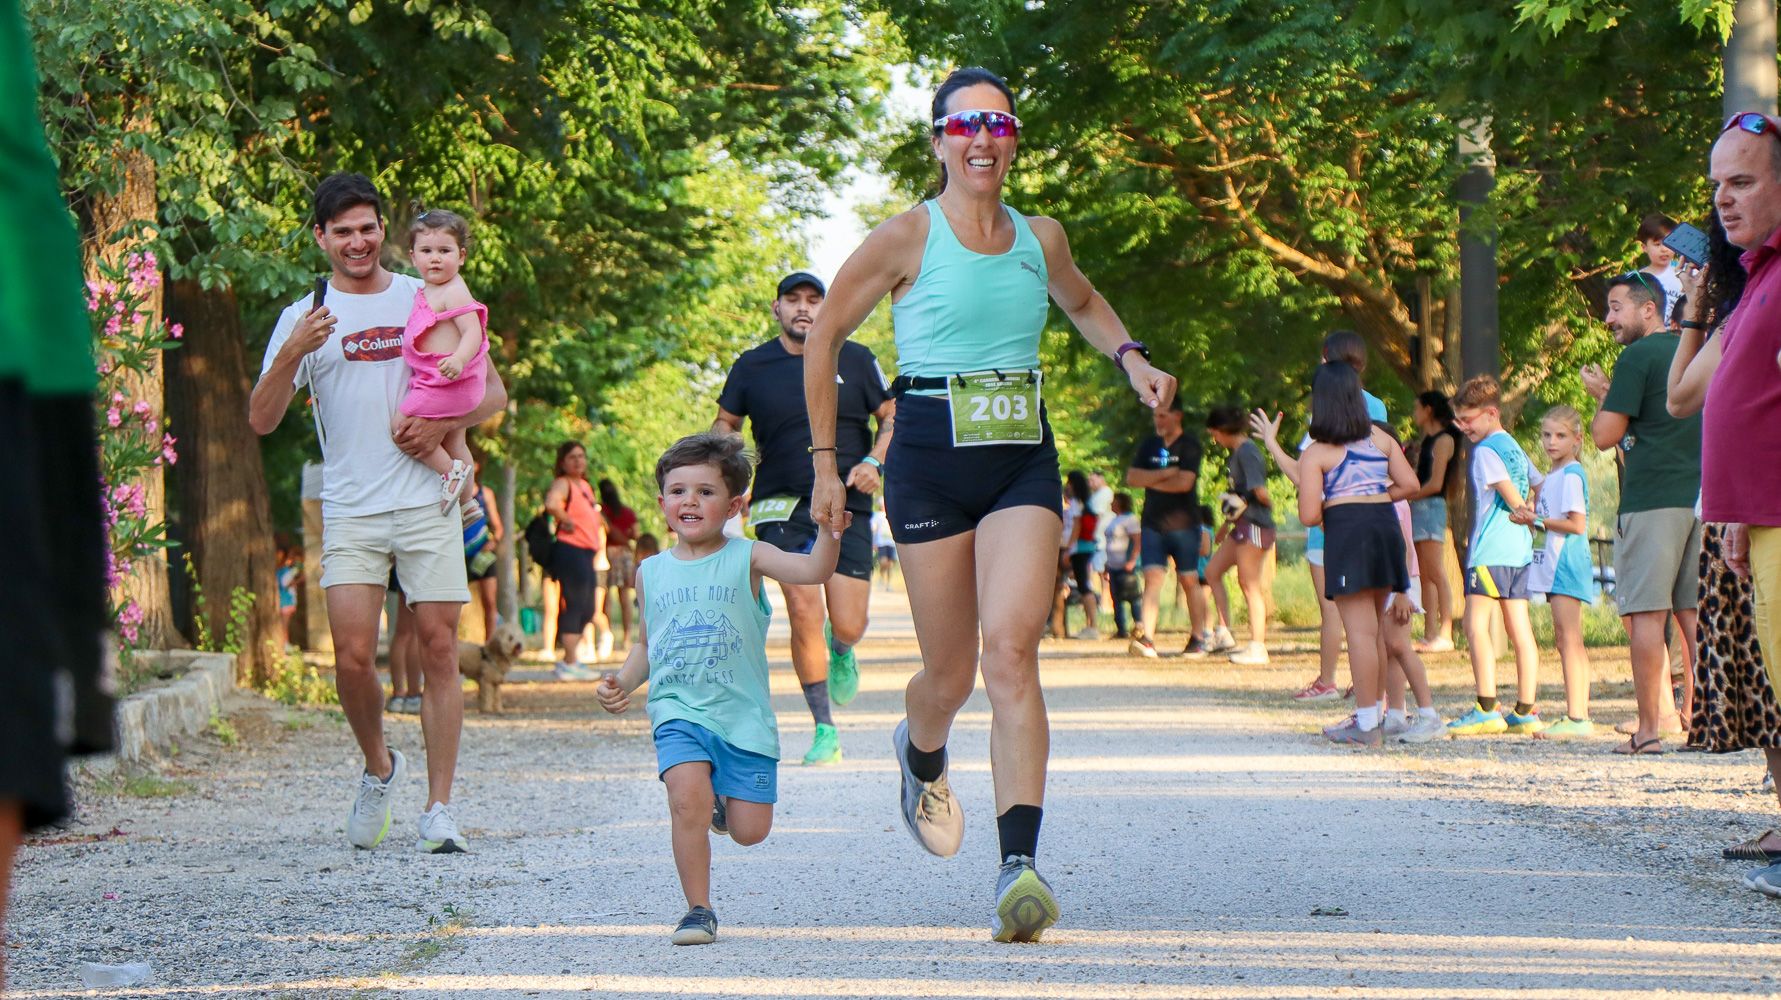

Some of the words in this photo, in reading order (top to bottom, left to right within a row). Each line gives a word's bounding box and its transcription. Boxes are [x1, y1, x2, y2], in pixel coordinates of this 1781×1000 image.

[359, 335, 403, 351] Colum
[970, 395, 1028, 421] 203
[758, 500, 788, 513] 128
[905, 521, 930, 530] CRAFT
[655, 585, 698, 610] EXPLORE
[708, 585, 738, 604] MORE
[705, 669, 734, 684] LESS
